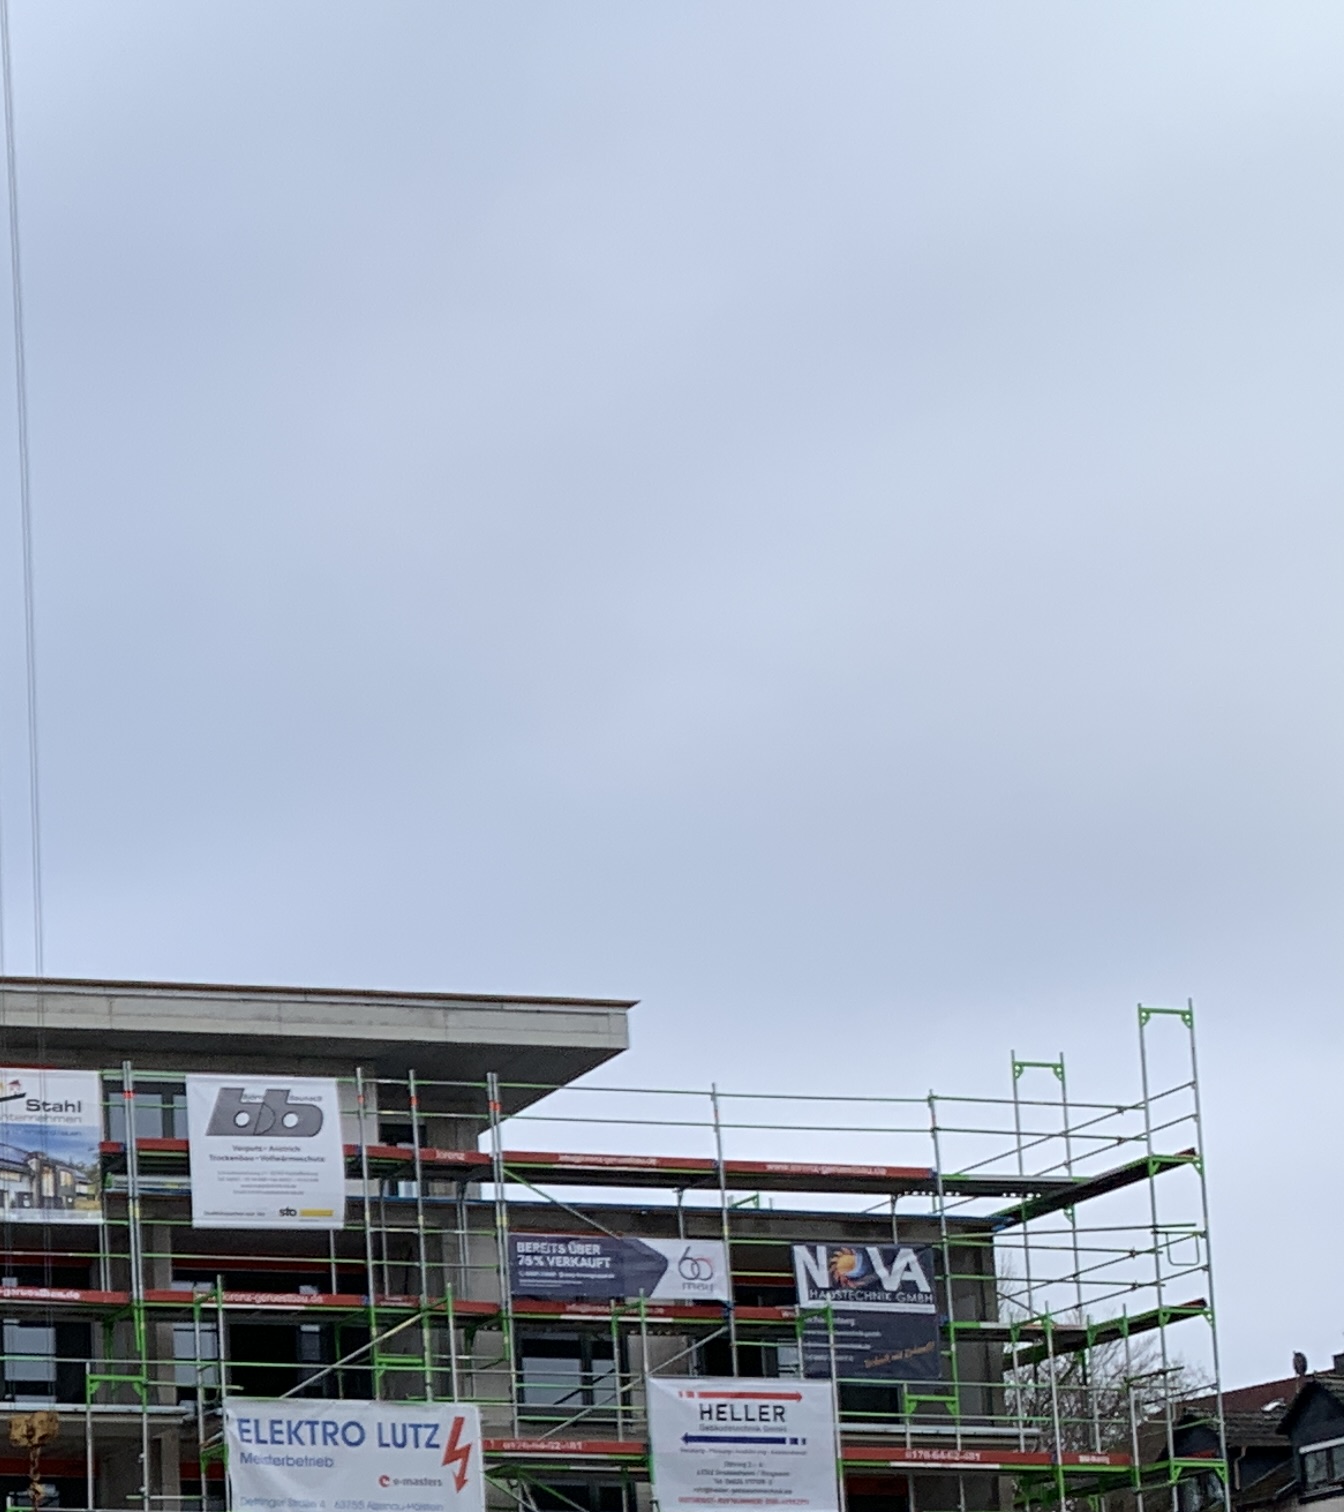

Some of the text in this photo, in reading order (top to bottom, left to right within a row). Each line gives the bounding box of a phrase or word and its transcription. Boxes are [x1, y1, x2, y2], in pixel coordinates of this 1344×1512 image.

[26, 1099, 81, 1113] Stahl
[516, 1241, 601, 1255] BEREITS ÜBER
[546, 1255, 611, 1269] VERKAUFT
[699, 1403, 786, 1423] HELLER
[237, 1417, 440, 1449] ELEKTRO LUTZ
[240, 1452, 334, 1468] Meisterbetrieb
